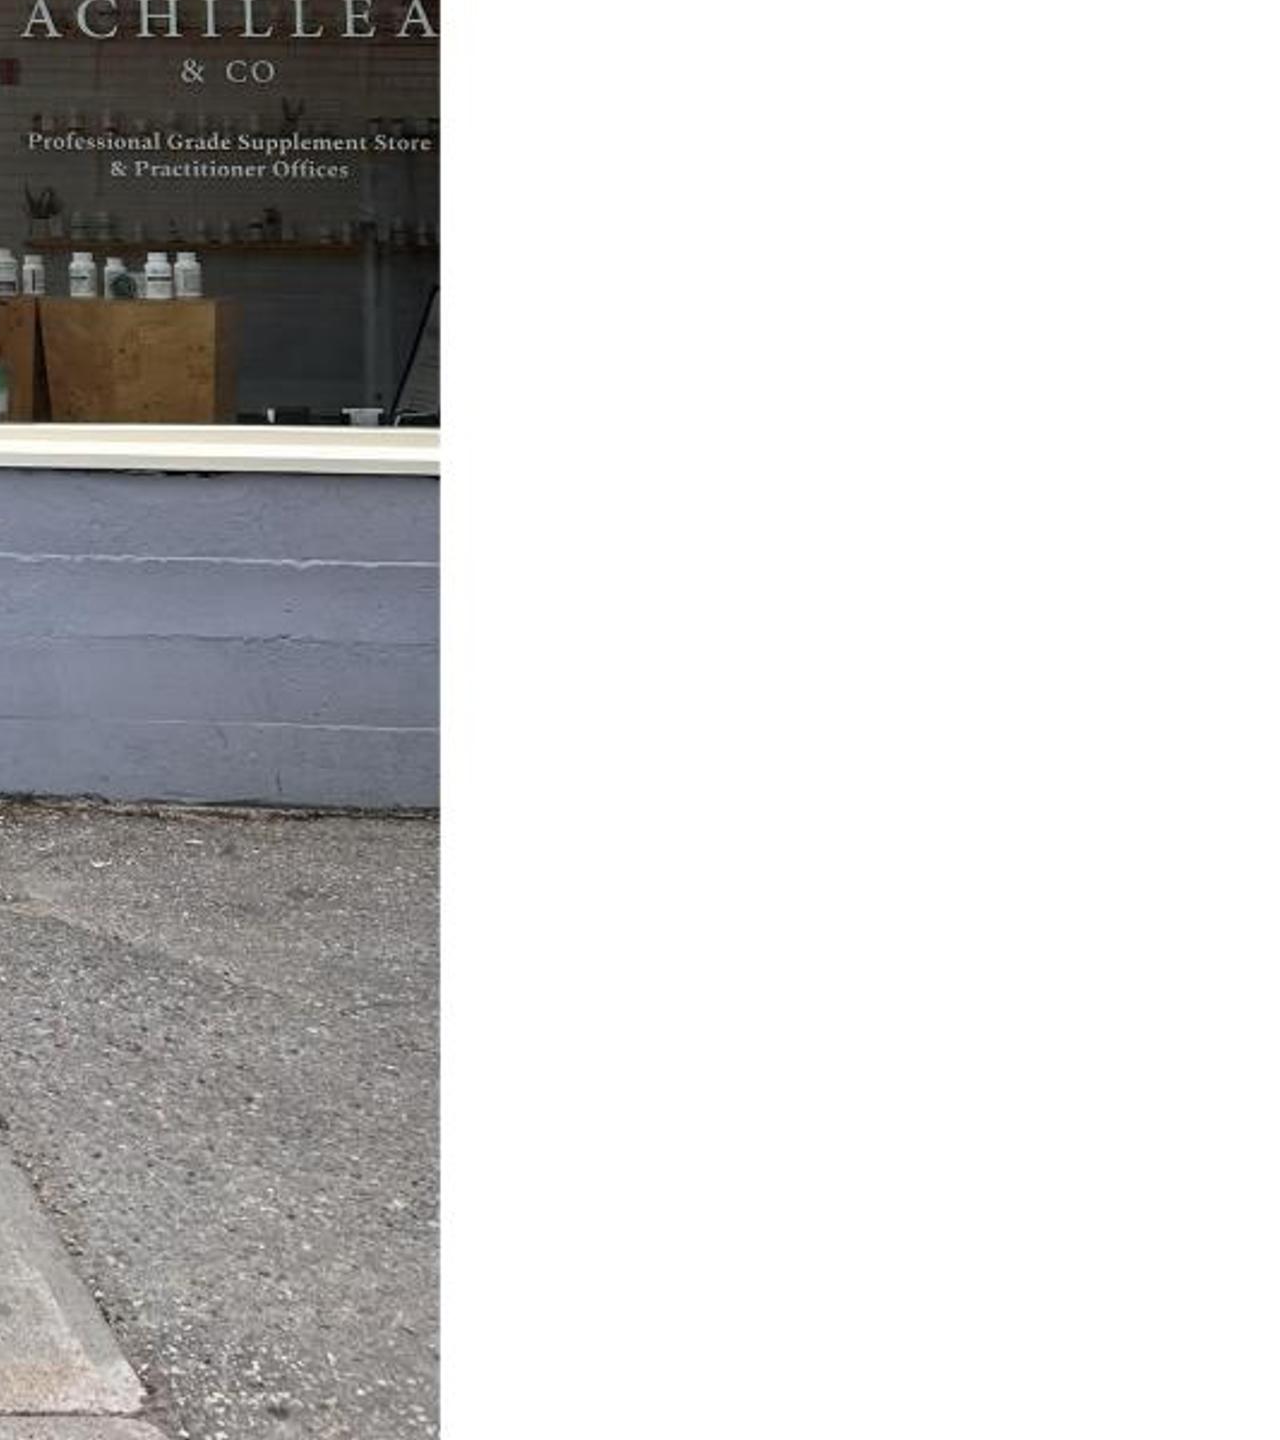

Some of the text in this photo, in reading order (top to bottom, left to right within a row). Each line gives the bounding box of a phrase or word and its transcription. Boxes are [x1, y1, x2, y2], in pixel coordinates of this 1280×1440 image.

[180, 59, 276, 84] & CO
[28, 131, 433, 155] Professional Grade Supplement Store
[110, 158, 350, 179] & Practitioner Offices
